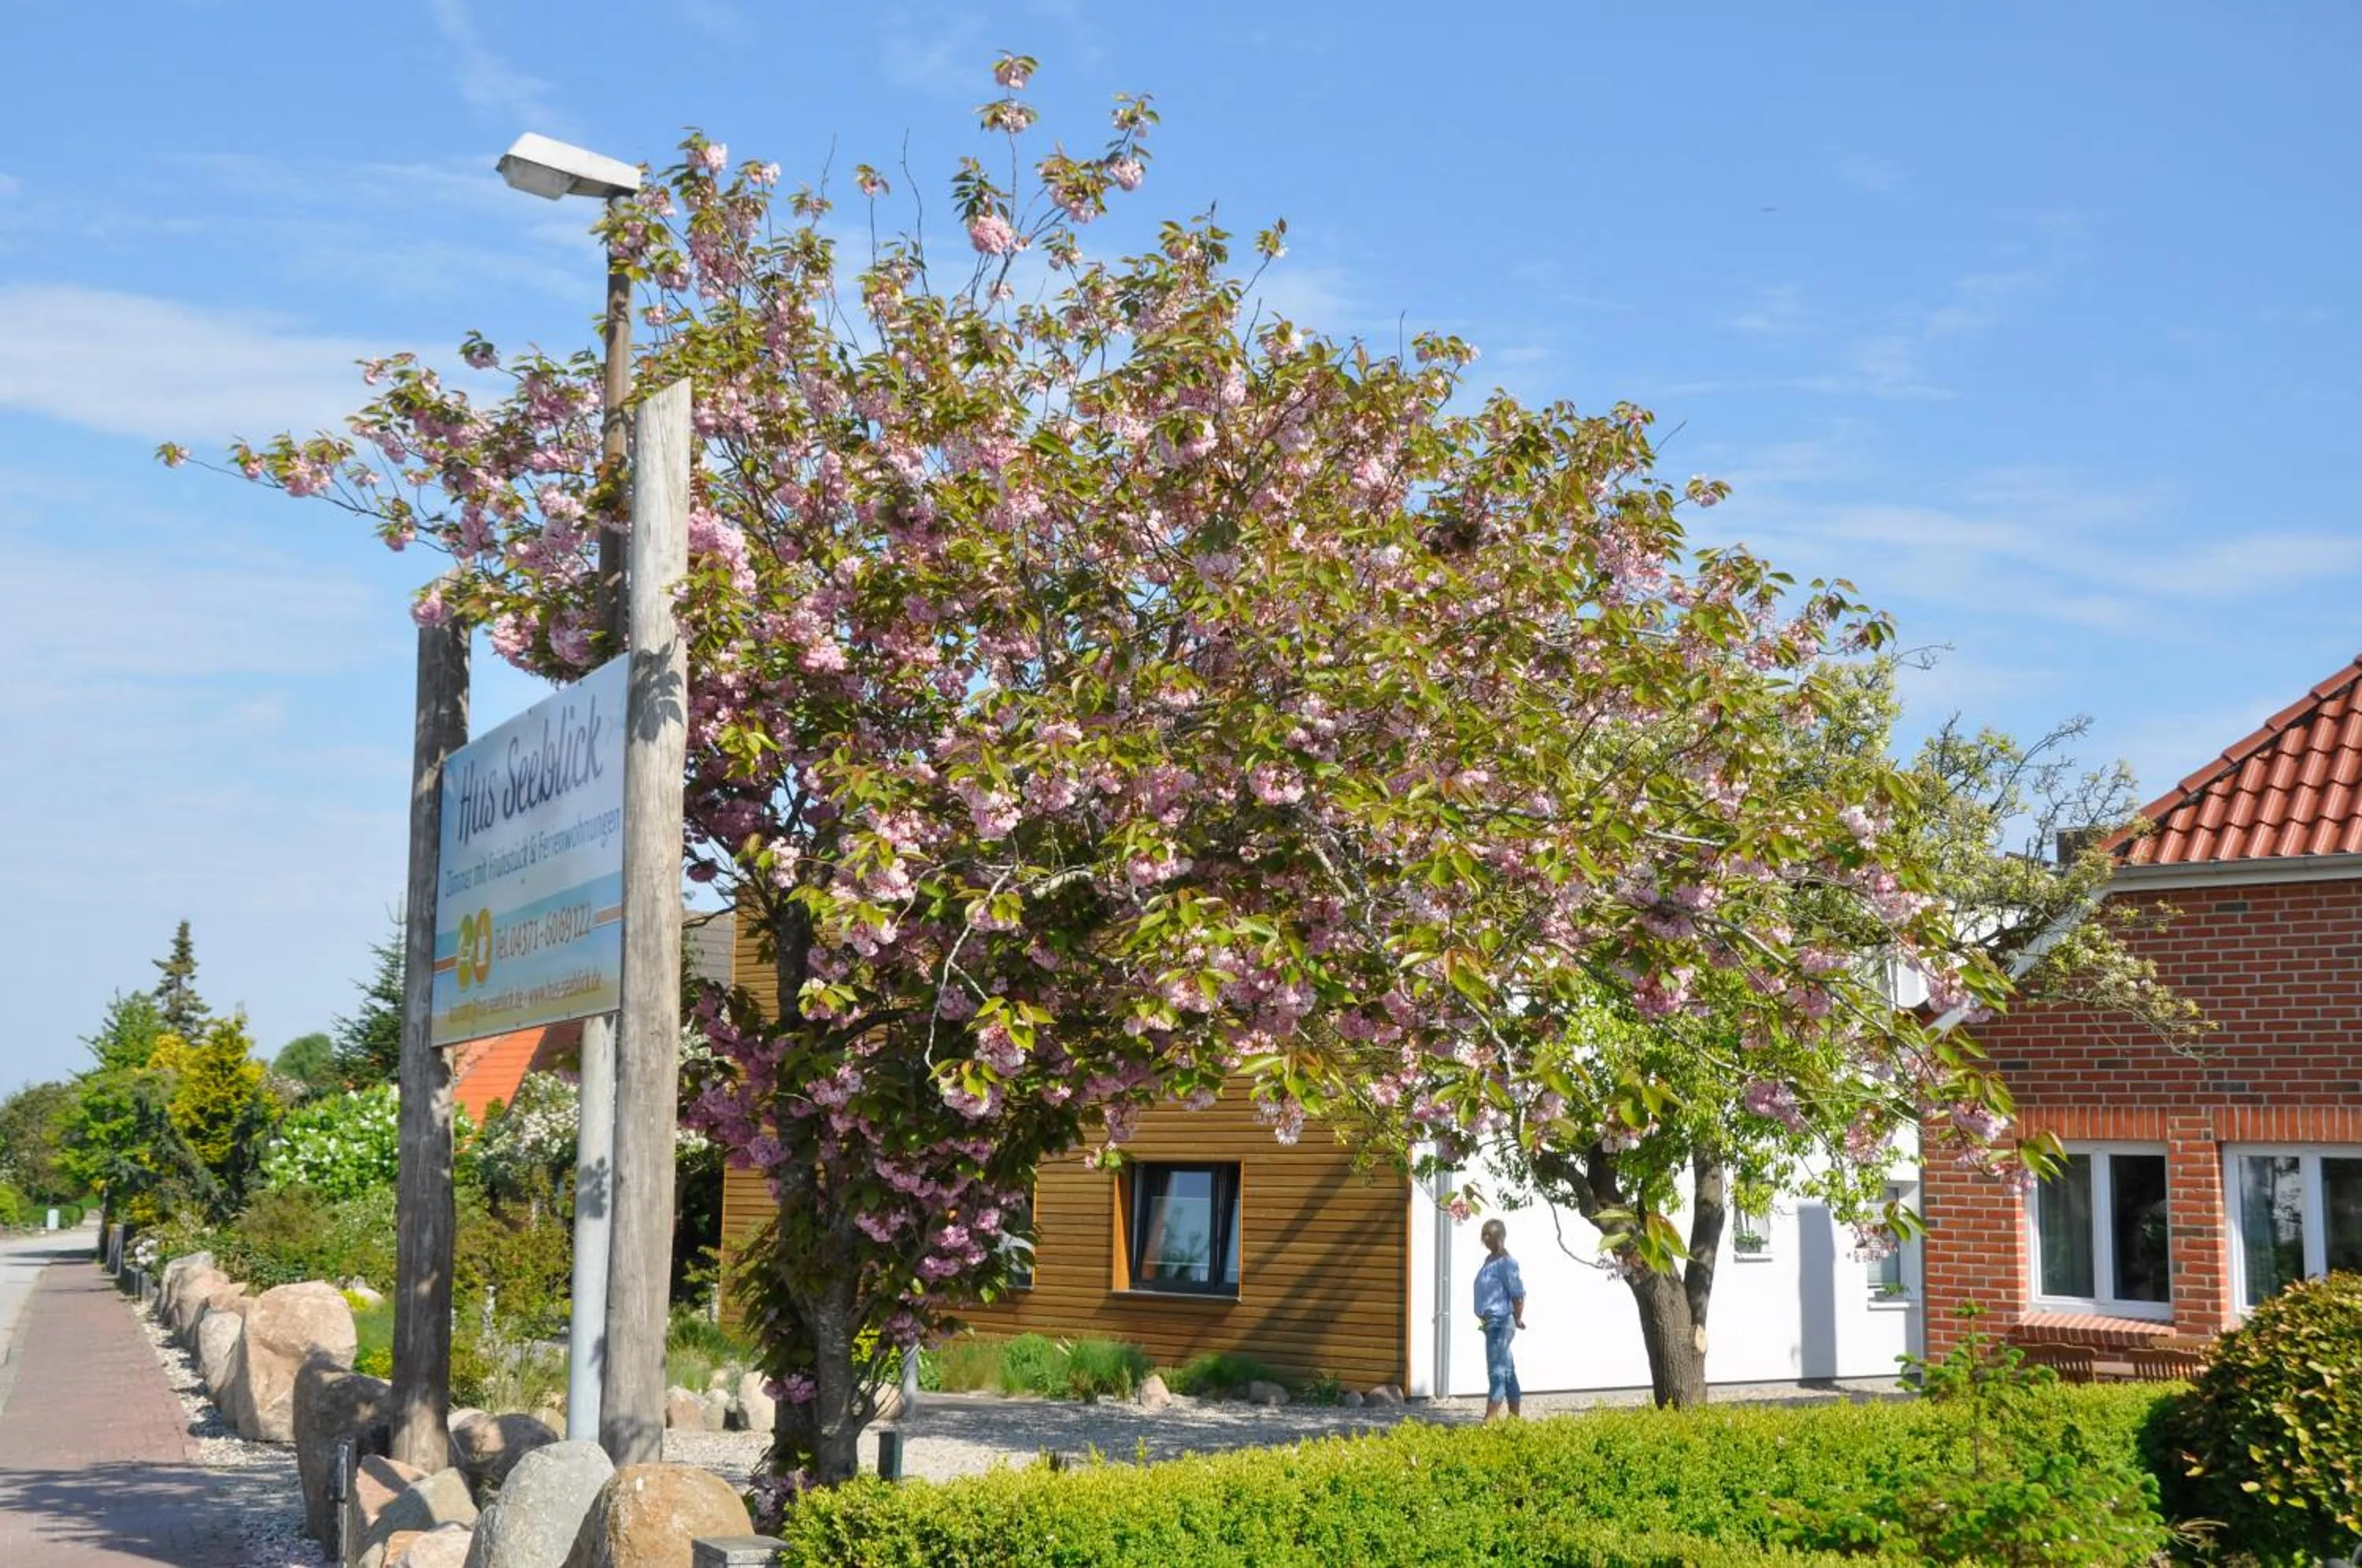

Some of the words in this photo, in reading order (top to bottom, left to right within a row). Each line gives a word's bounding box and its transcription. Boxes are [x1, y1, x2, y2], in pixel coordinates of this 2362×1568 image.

[457, 758, 497, 845] Hus
[502, 693, 604, 820] Seeblick
[446, 868, 472, 897] Zimmer
[474, 856, 487, 886] mit
[529, 834, 536, 864] &
[539, 808, 620, 860] Ferienwohnungen
